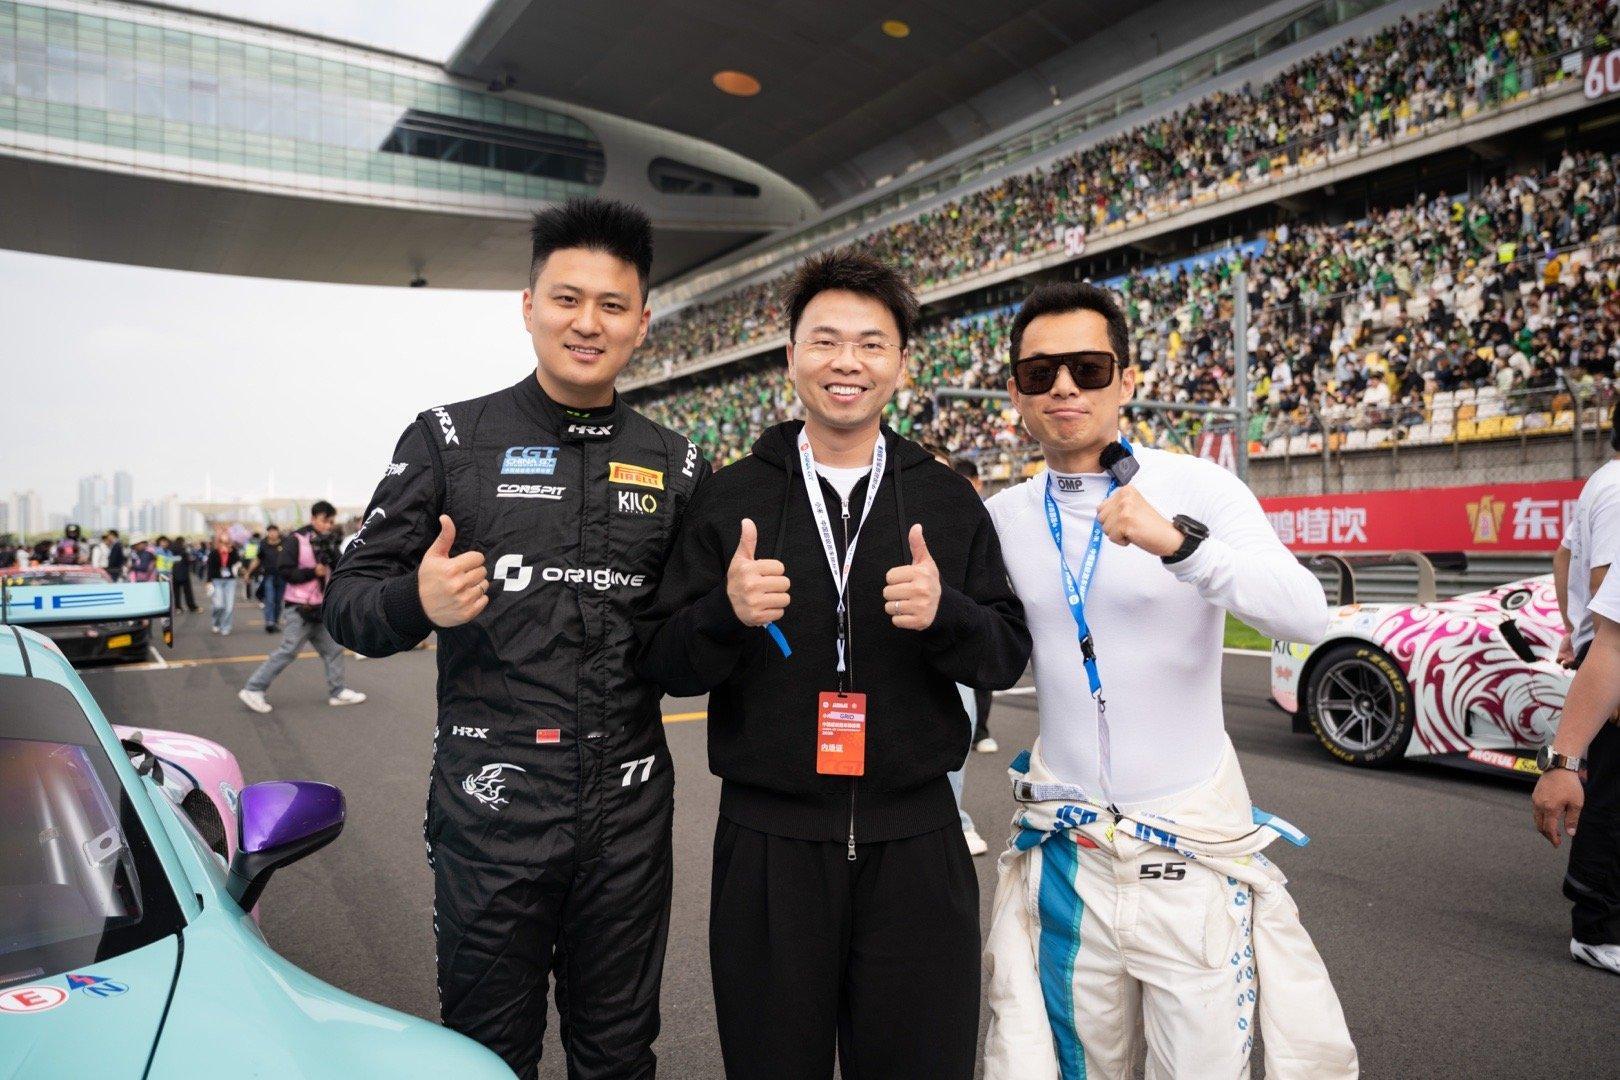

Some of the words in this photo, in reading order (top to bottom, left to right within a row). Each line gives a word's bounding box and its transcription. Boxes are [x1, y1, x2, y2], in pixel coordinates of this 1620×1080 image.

[431, 406, 460, 446] HRX
[567, 424, 614, 436] HRX
[505, 446, 561, 459] CGT
[614, 465, 658, 486] PIRELLI
[1058, 478, 1083, 491] OMP
[617, 490, 658, 514] KILO
[452, 725, 490, 739] HRX
[619, 754, 656, 787] 77
[1139, 861, 1187, 881] 55
